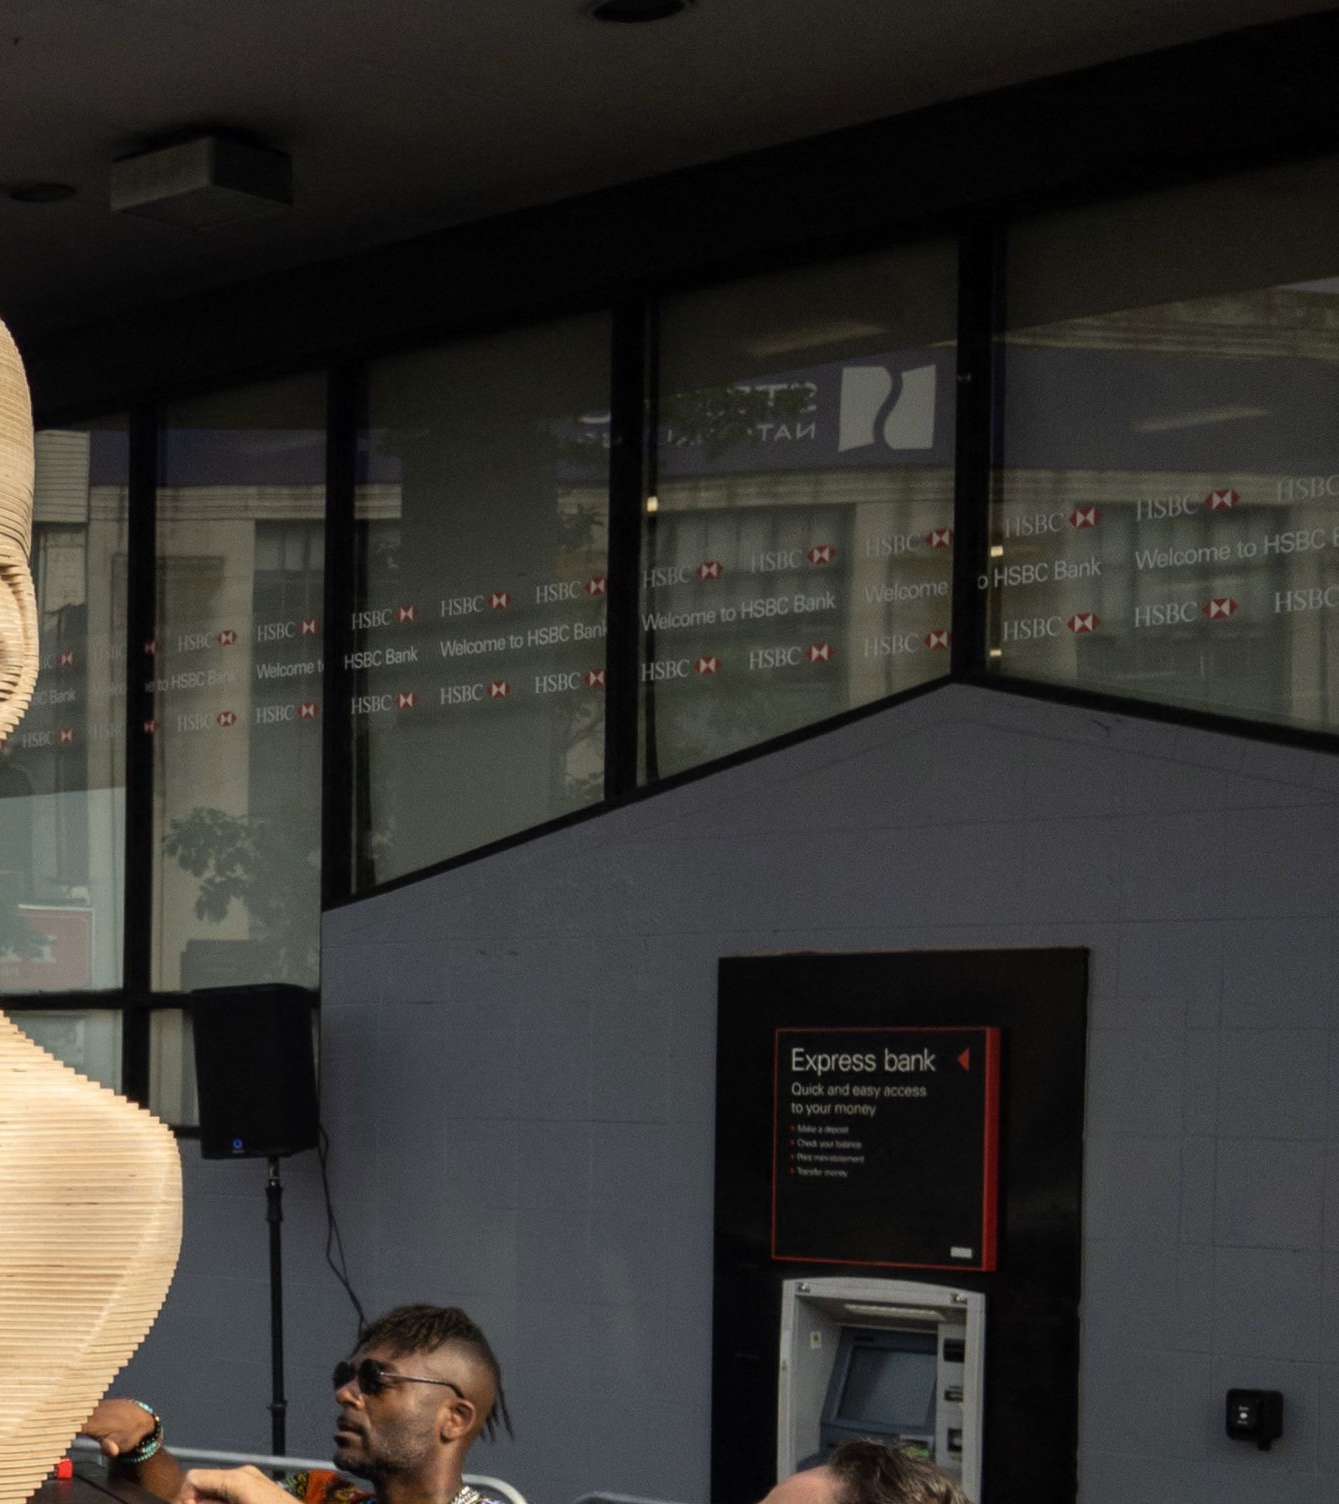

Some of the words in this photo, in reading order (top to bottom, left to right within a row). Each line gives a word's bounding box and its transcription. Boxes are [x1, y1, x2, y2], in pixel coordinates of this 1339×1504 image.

[1136, 493, 1199, 522] HSBC
[1005, 512, 1065, 538] HSBC
[1136, 546, 1230, 570] Welcome
[1236, 541, 1257, 558] to
[1264, 529, 1326, 555] HSBC
[978, 576, 988, 590] o
[994, 563, 1048, 587] HSBC
[1054, 556, 1102, 580] Bank
[536, 581, 581, 603] HSBC
[441, 595, 485, 617] HSBC
[642, 610, 716, 631] Welcome
[721, 607, 736, 622] to
[741, 597, 788, 619] HSBC
[794, 591, 836, 613] Bank
[1135, 601, 1197, 627] HSBC
[352, 609, 393, 630] HSBC
[1003, 615, 1062, 641] HSBC
[257, 621, 296, 642] HSBC
[440, 637, 506, 657] Welcome
[510, 634, 523, 649] to
[528, 625, 570, 646] HSBC
[344, 650, 383, 669] HSBC
[385, 646, 418, 664] Bank
[749, 646, 801, 670] HSBC
[172, 671, 204, 689] HSBC
[256, 661, 314, 680] Welcome
[642, 659, 691, 681] HSBC
[440, 684, 483, 704] HSBC
[535, 672, 580, 694] HSBC
[255, 704, 295, 724] HSBC
[351, 694, 392, 715] HSBC
[792, 1047, 876, 1076] Express
[884, 1048, 936, 1072] bank
[791, 1082, 824, 1096] Quick
[827, 1083, 850, 1096] and
[852, 1085, 881, 1098] easy
[883, 1085, 927, 1098] access
[791, 1103, 803, 1113] to
[806, 1104, 831, 1116] your
[835, 1104, 876, 1117] money
